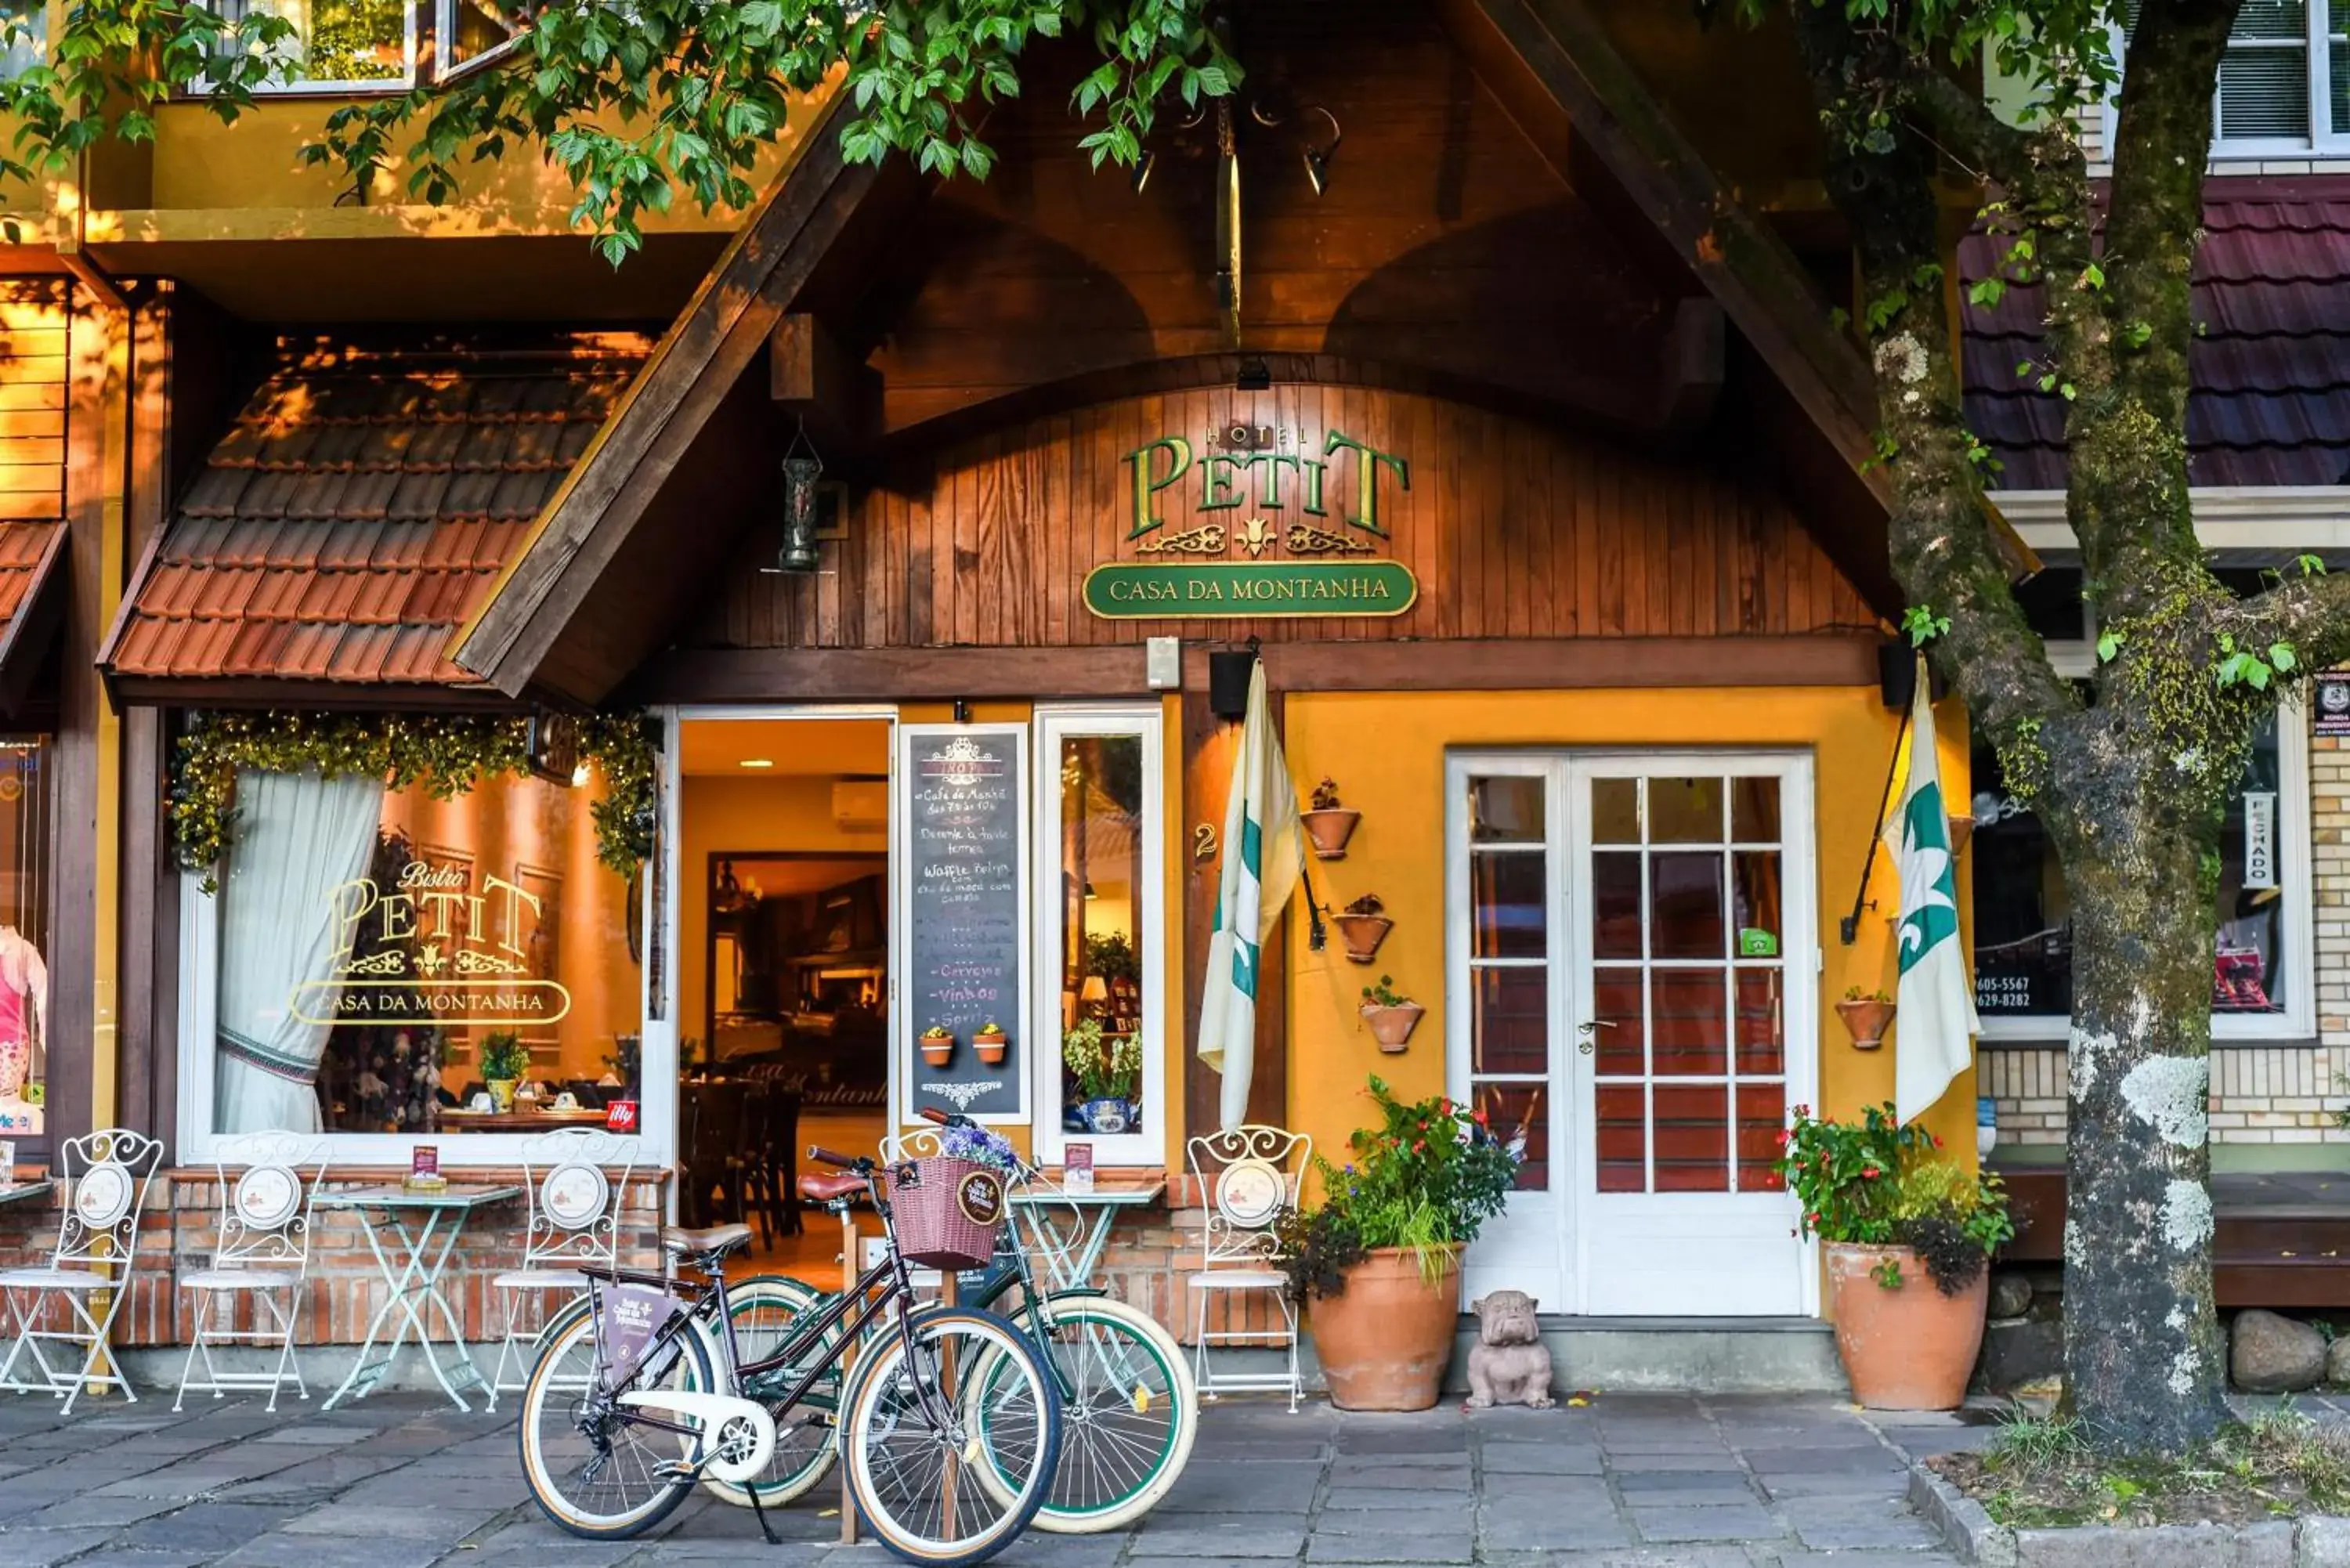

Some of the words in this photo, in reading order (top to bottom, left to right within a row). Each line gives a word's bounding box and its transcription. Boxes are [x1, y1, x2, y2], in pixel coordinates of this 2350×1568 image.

[1206, 426, 1307, 444] HOTEL
[1122, 428, 1411, 541] PETIT
[1109, 579, 1178, 602] CASA
[1188, 579, 1224, 601] DA
[1231, 577, 1390, 601] MONTANHA
[924, 864, 970, 878] Waffle
[326, 873, 541, 961] PETIT
[1974, 976, 2030, 991] 605-5567
[316, 995, 372, 1011] CASA
[379, 995, 408, 1011] DA
[415, 994, 544, 1010] MONTANHA
[1974, 992, 2031, 1007] 629-8282
[609, 1104, 634, 1126] illy
